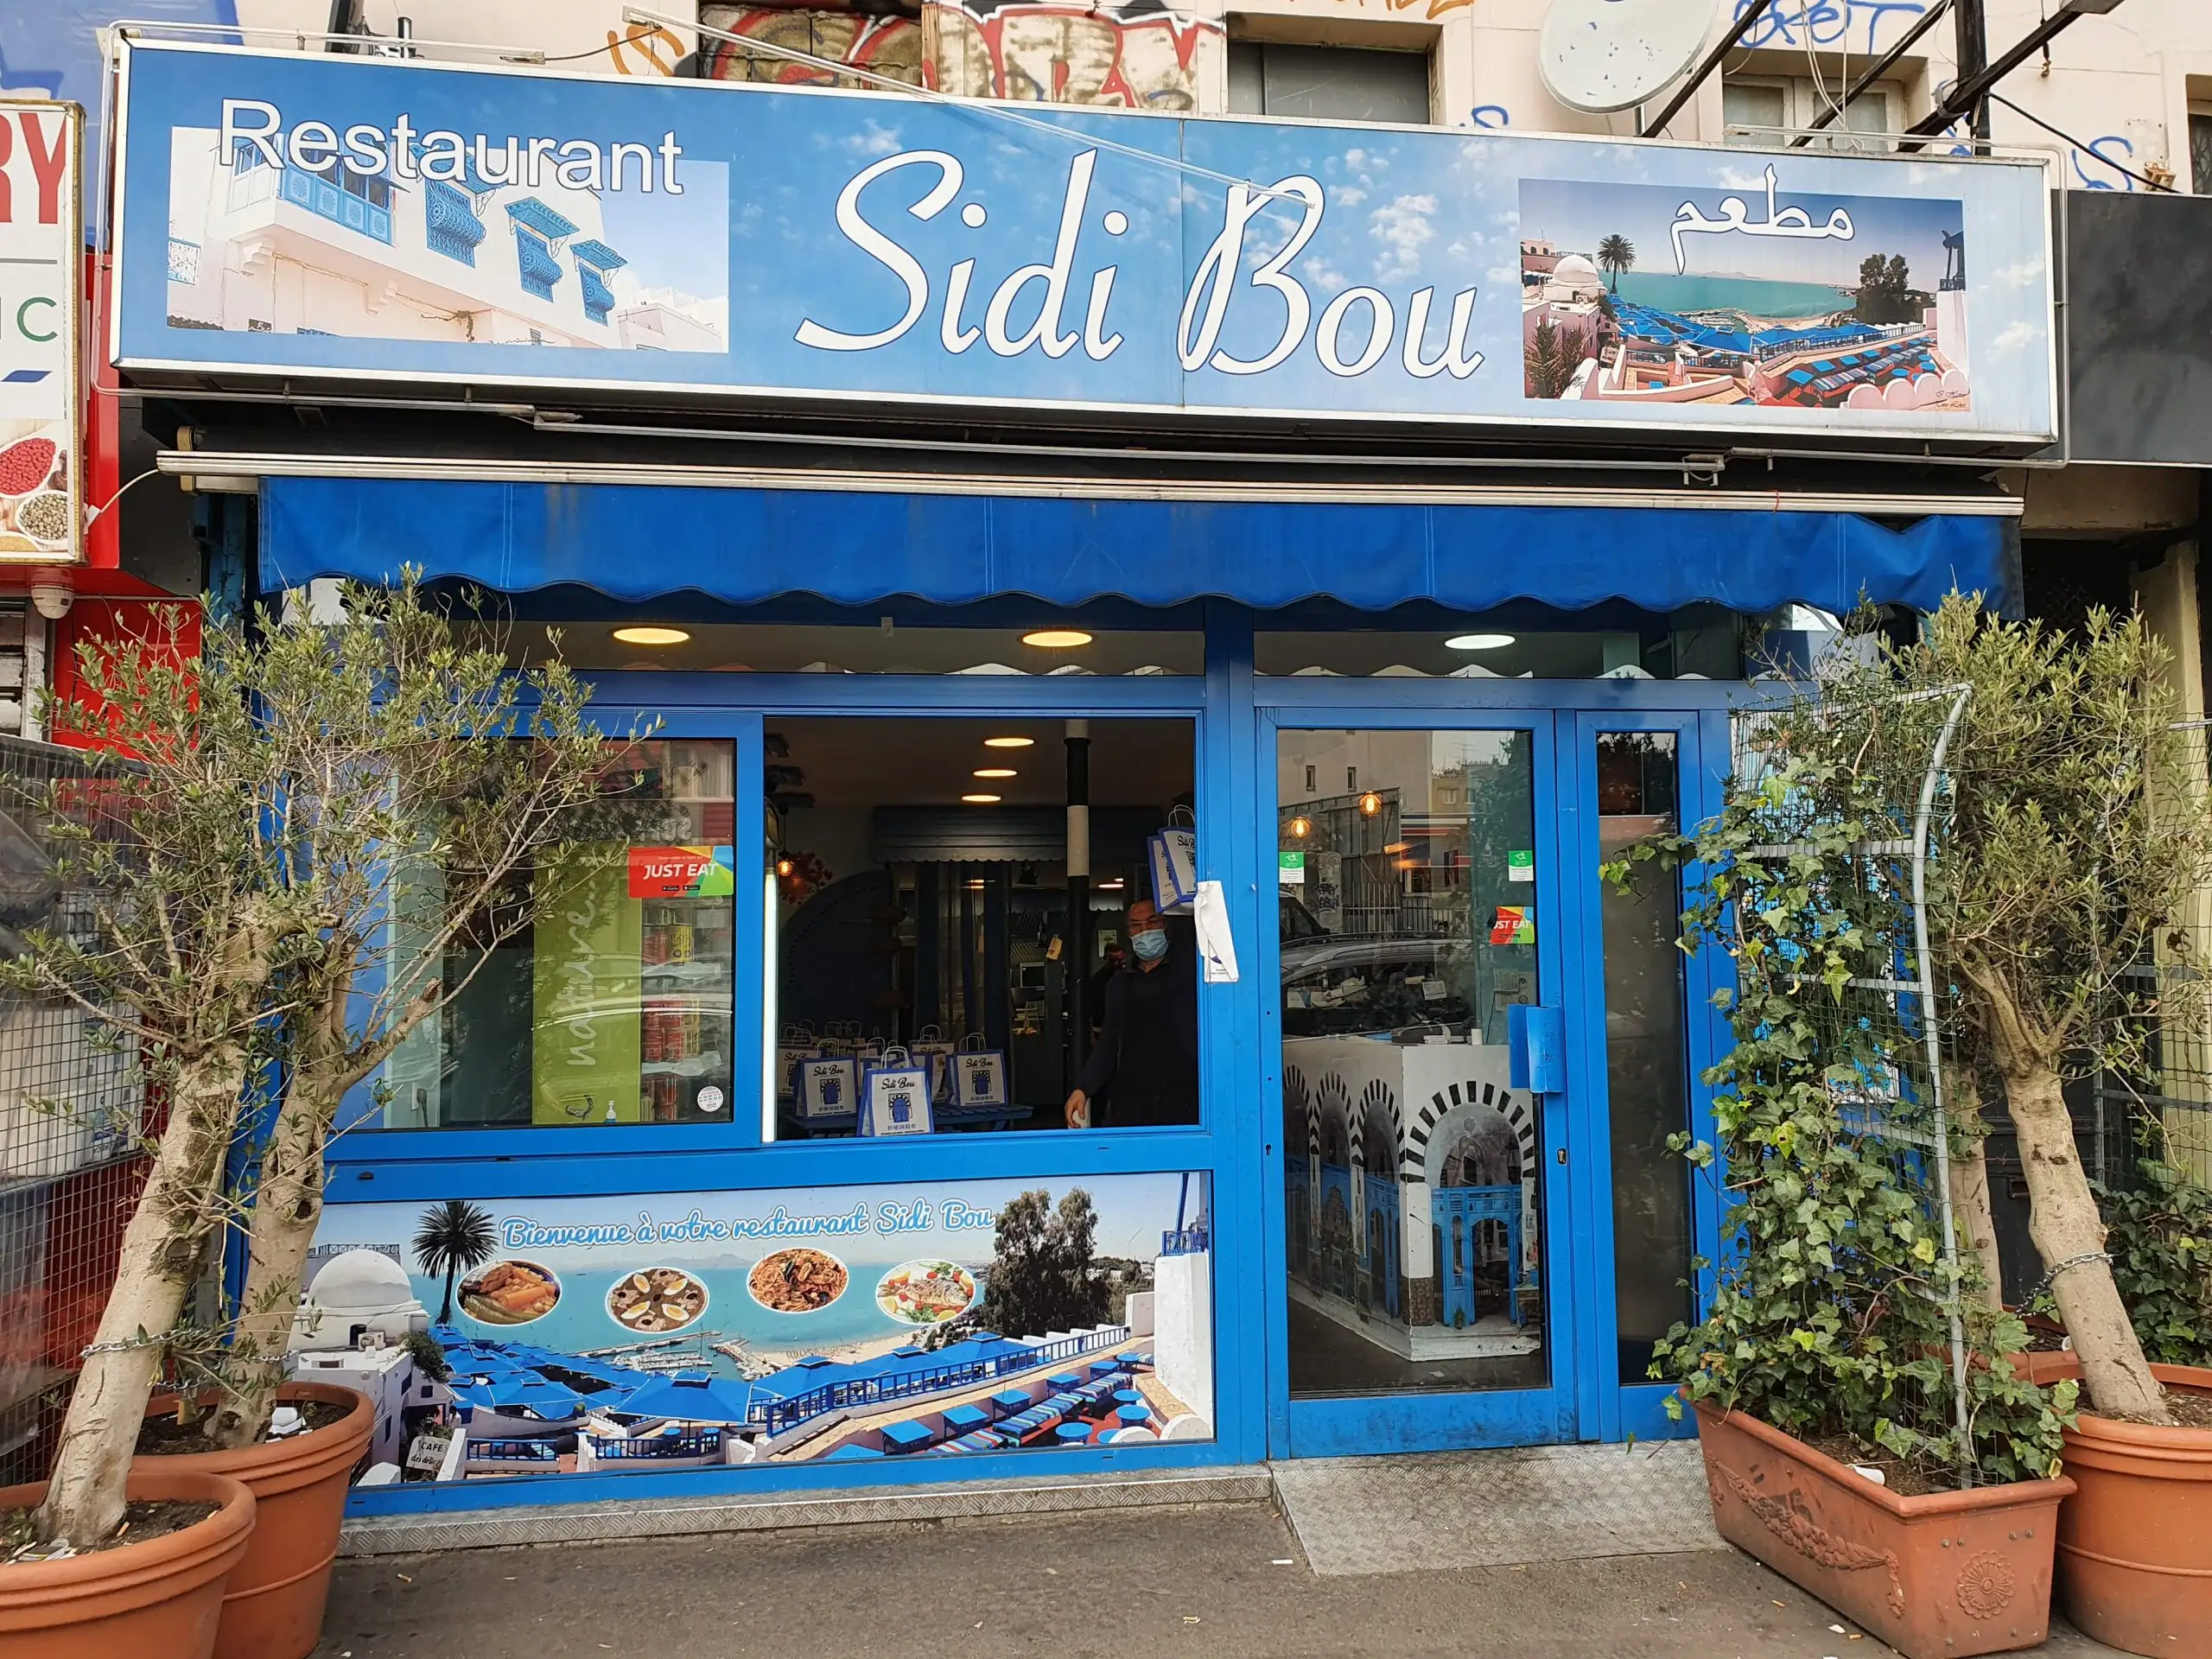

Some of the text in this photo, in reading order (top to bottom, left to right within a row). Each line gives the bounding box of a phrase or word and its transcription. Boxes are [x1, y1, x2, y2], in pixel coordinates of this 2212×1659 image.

[219, 98, 684, 195] Restaurant
[1670, 163, 1855, 275] مطعم
[793, 148, 1484, 378] Sidi Bou
[643, 863, 719, 880] JUST EAT
[1512, 920, 1531, 929] EAT
[813, 1065, 844, 1076] Sidi Bou
[966, 1058, 993, 1068] Sidi Bou
[881, 1077, 915, 1090] Sidi Bou
[500, 1197, 996, 1250] Bienvenue à votre restaurant Sidi Bou
